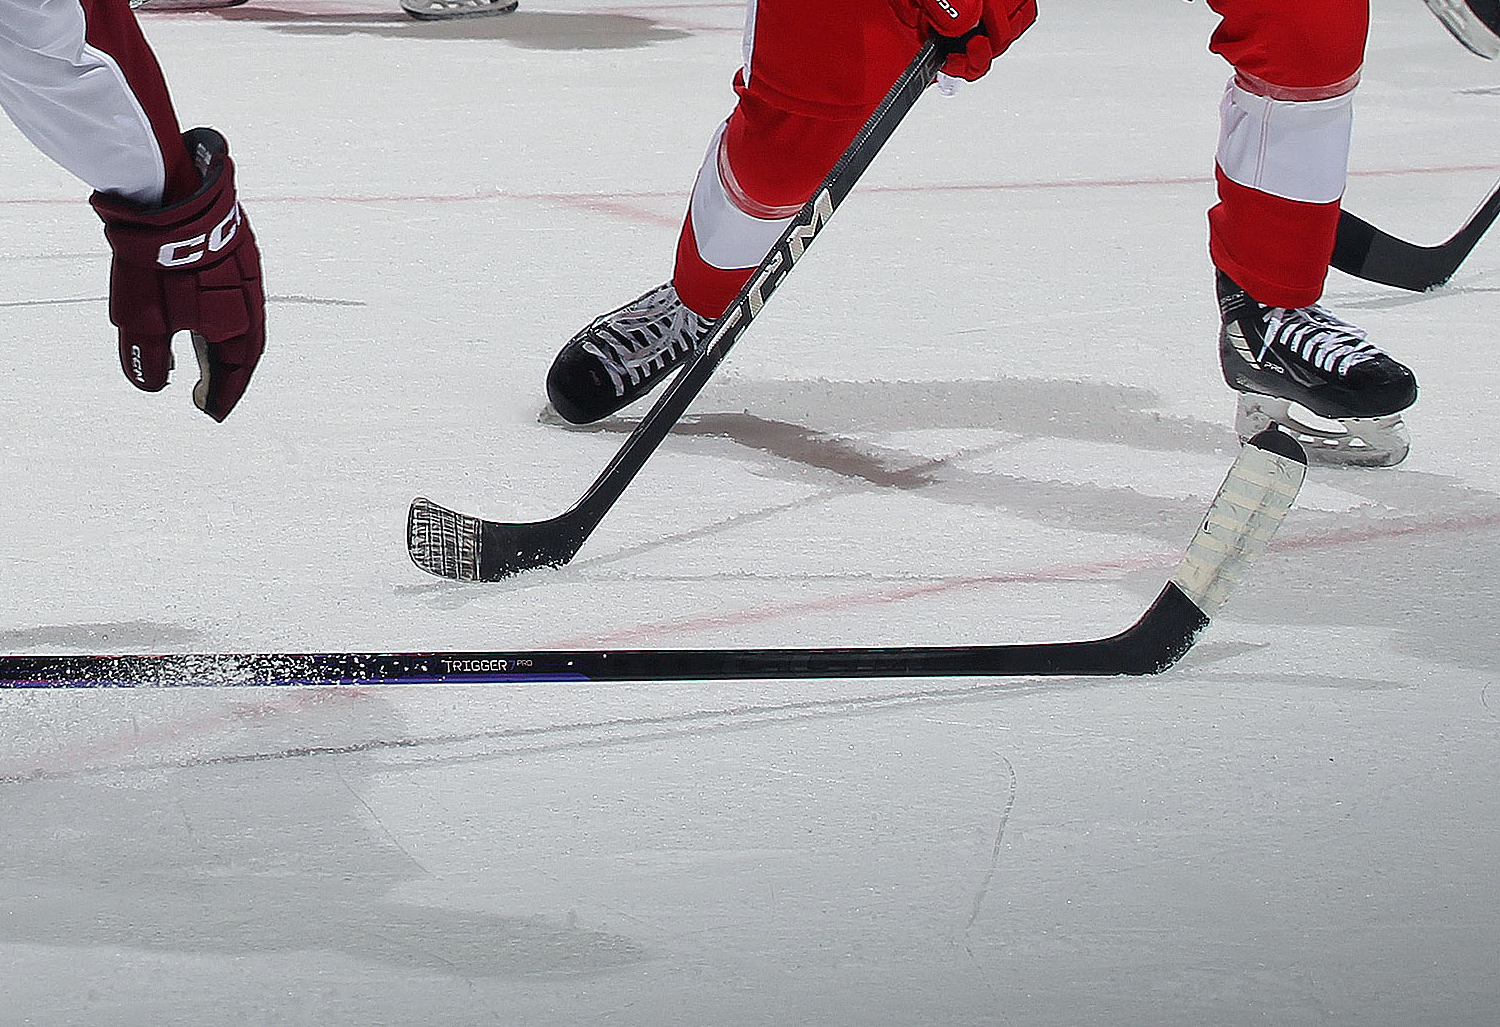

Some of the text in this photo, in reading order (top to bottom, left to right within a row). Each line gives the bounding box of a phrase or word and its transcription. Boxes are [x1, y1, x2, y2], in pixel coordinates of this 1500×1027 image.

[156, 202, 241, 268] CC
[706, 186, 835, 357] CCM
[1263, 362, 1285, 375] PRO
[443, 659, 508, 672] TRIGGER
[516, 659, 533, 667] PRO
